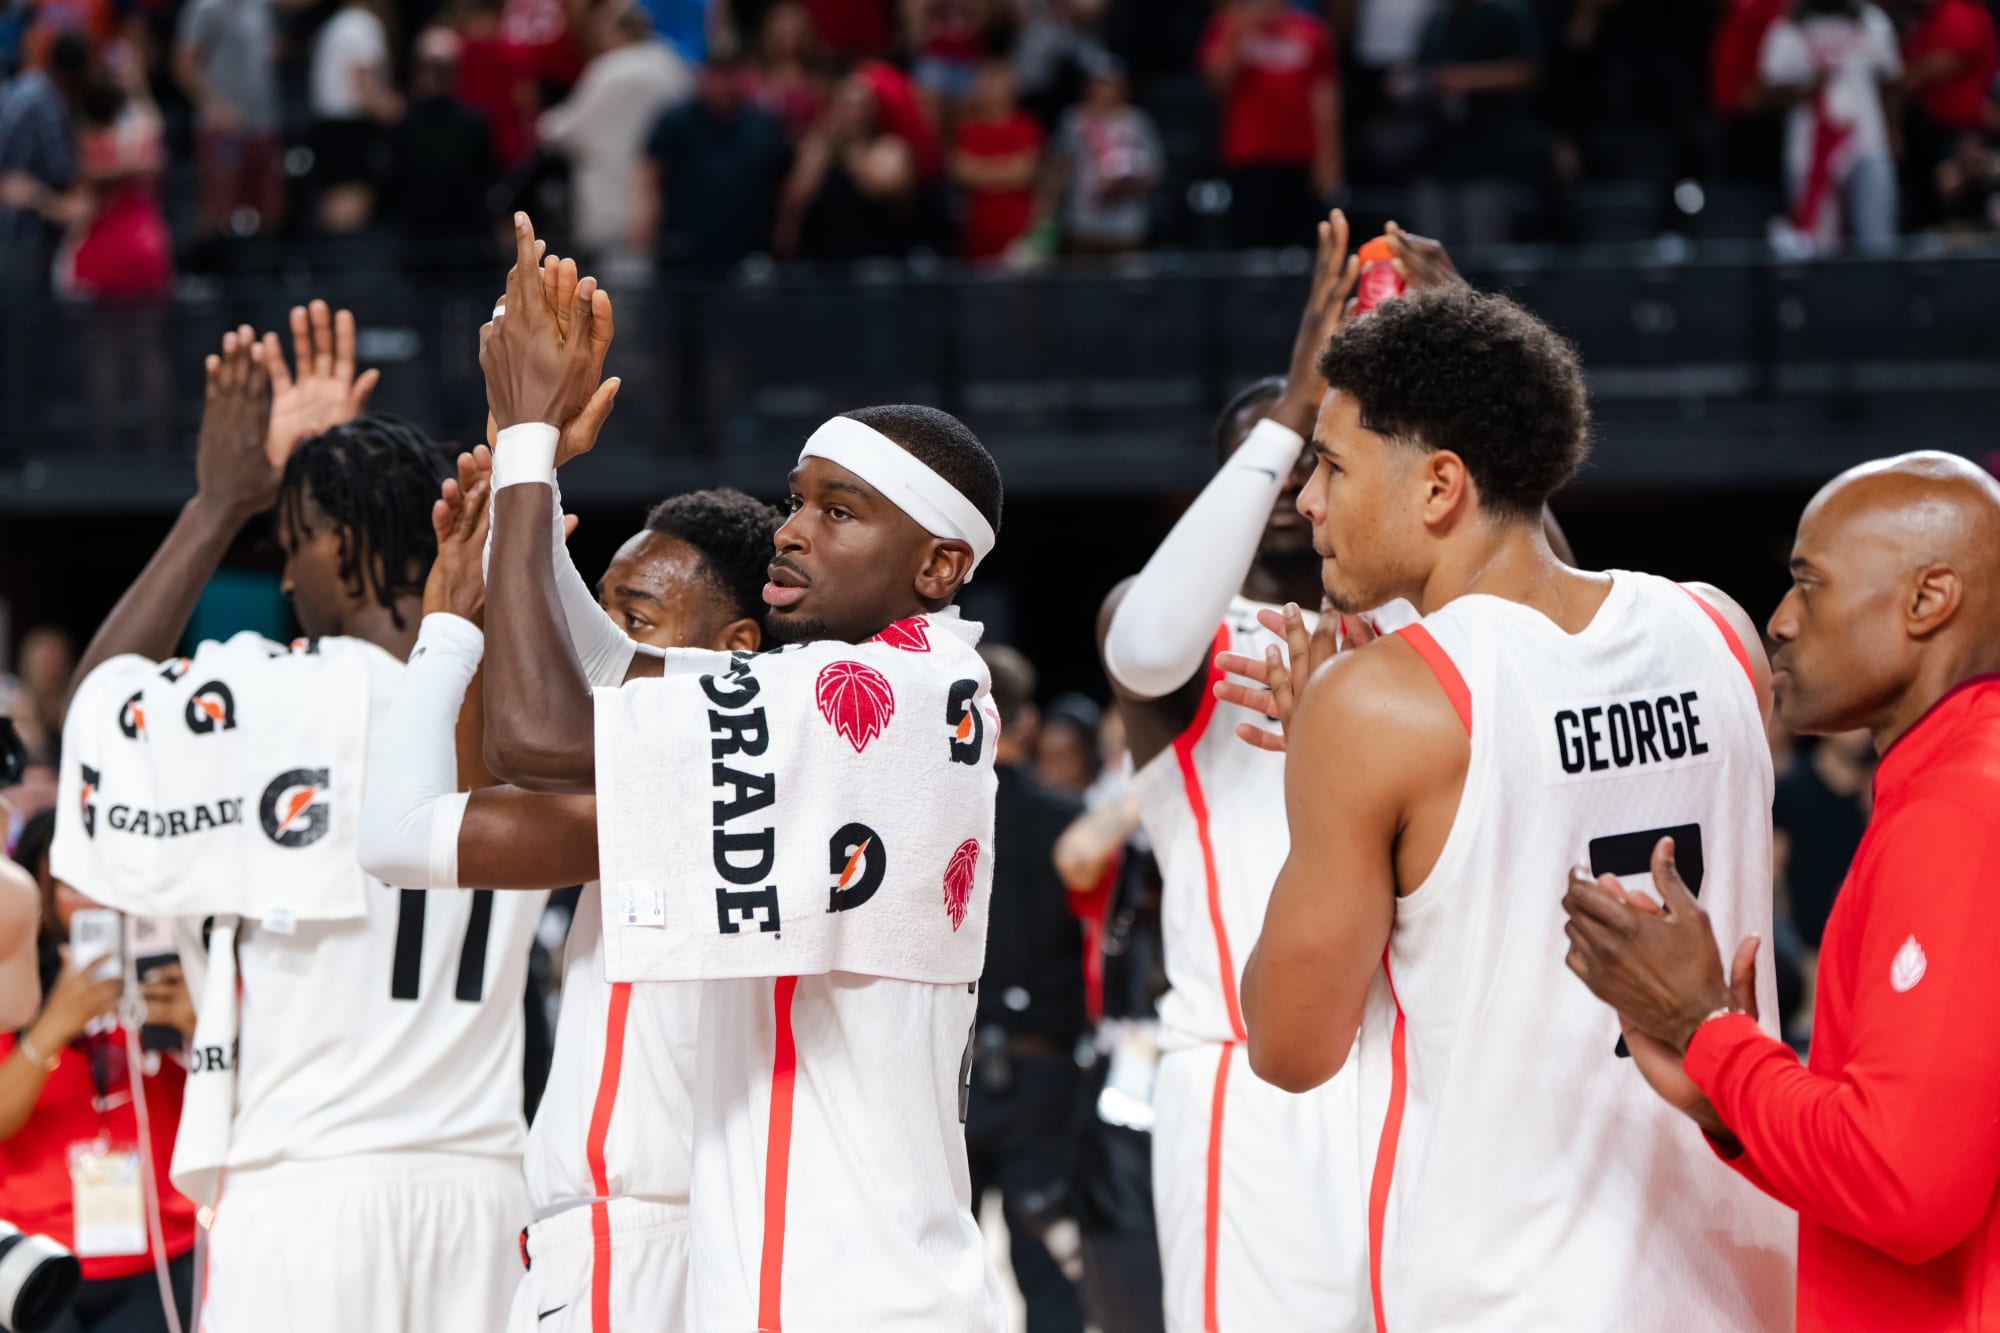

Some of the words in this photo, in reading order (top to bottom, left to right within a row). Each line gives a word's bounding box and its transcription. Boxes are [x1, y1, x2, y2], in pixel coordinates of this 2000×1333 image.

[1554, 691, 1709, 774] GEORGE
[259, 767, 330, 849] G
[699, 649, 782, 934] ORADE
